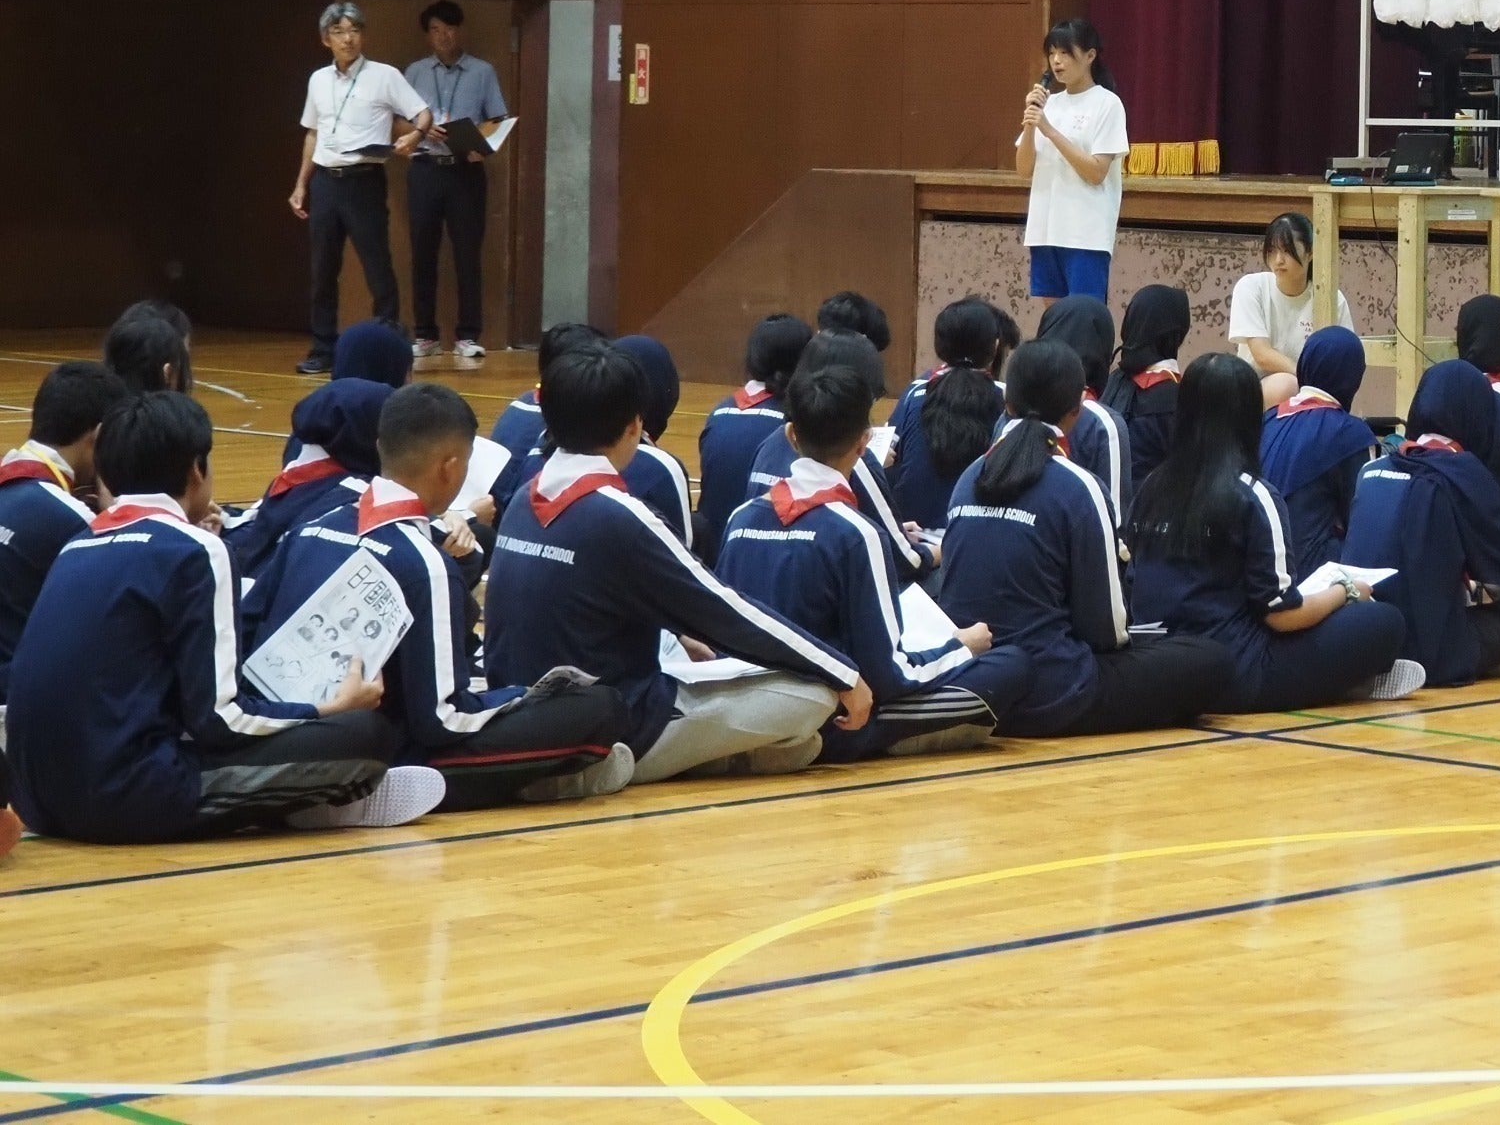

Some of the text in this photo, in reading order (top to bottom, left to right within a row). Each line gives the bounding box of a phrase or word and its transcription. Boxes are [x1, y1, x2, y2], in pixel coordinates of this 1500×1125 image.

[961, 505, 1005, 518] INDONESIAN
[1004, 507, 1037, 527] SCHOOL
[541, 545, 575, 565] SCHOOL
